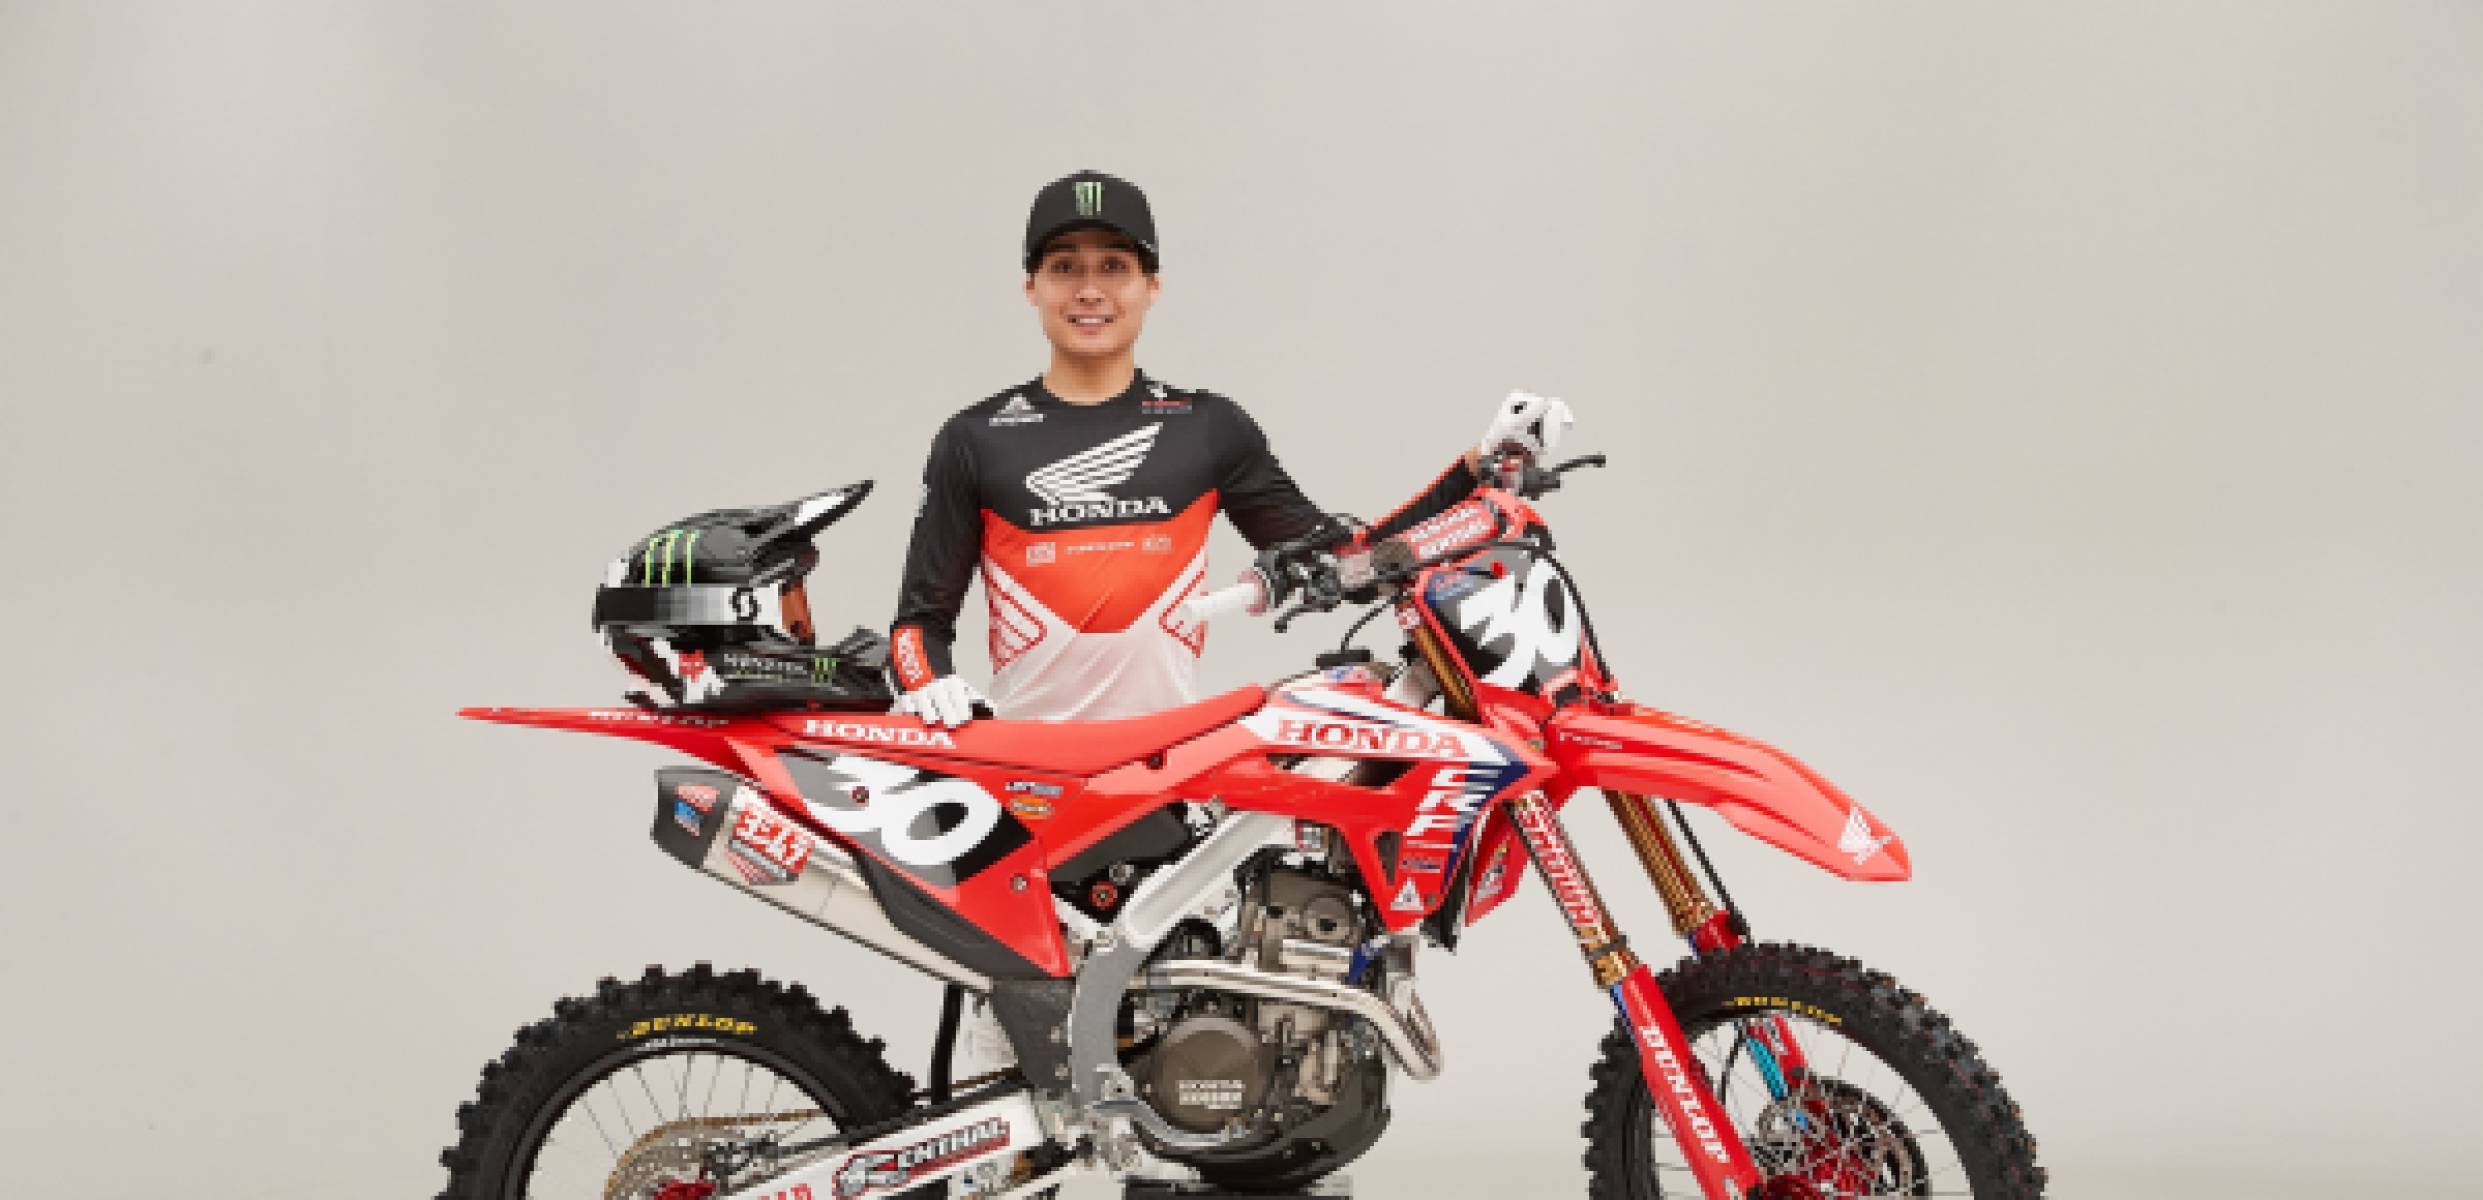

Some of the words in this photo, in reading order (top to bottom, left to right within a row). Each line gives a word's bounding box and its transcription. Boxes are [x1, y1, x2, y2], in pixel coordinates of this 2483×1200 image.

[1030, 496, 1171, 526] HONDA
[1460, 558, 1581, 690] 30
[804, 718, 957, 750] HONDA
[1278, 718, 1470, 758] HONDA
[804, 753, 1003, 867] 30
[1403, 764, 1500, 837] CRF
[632, 1013, 758, 1036] DUNLOP
[1640, 1024, 1730, 1164] DUNLOP
